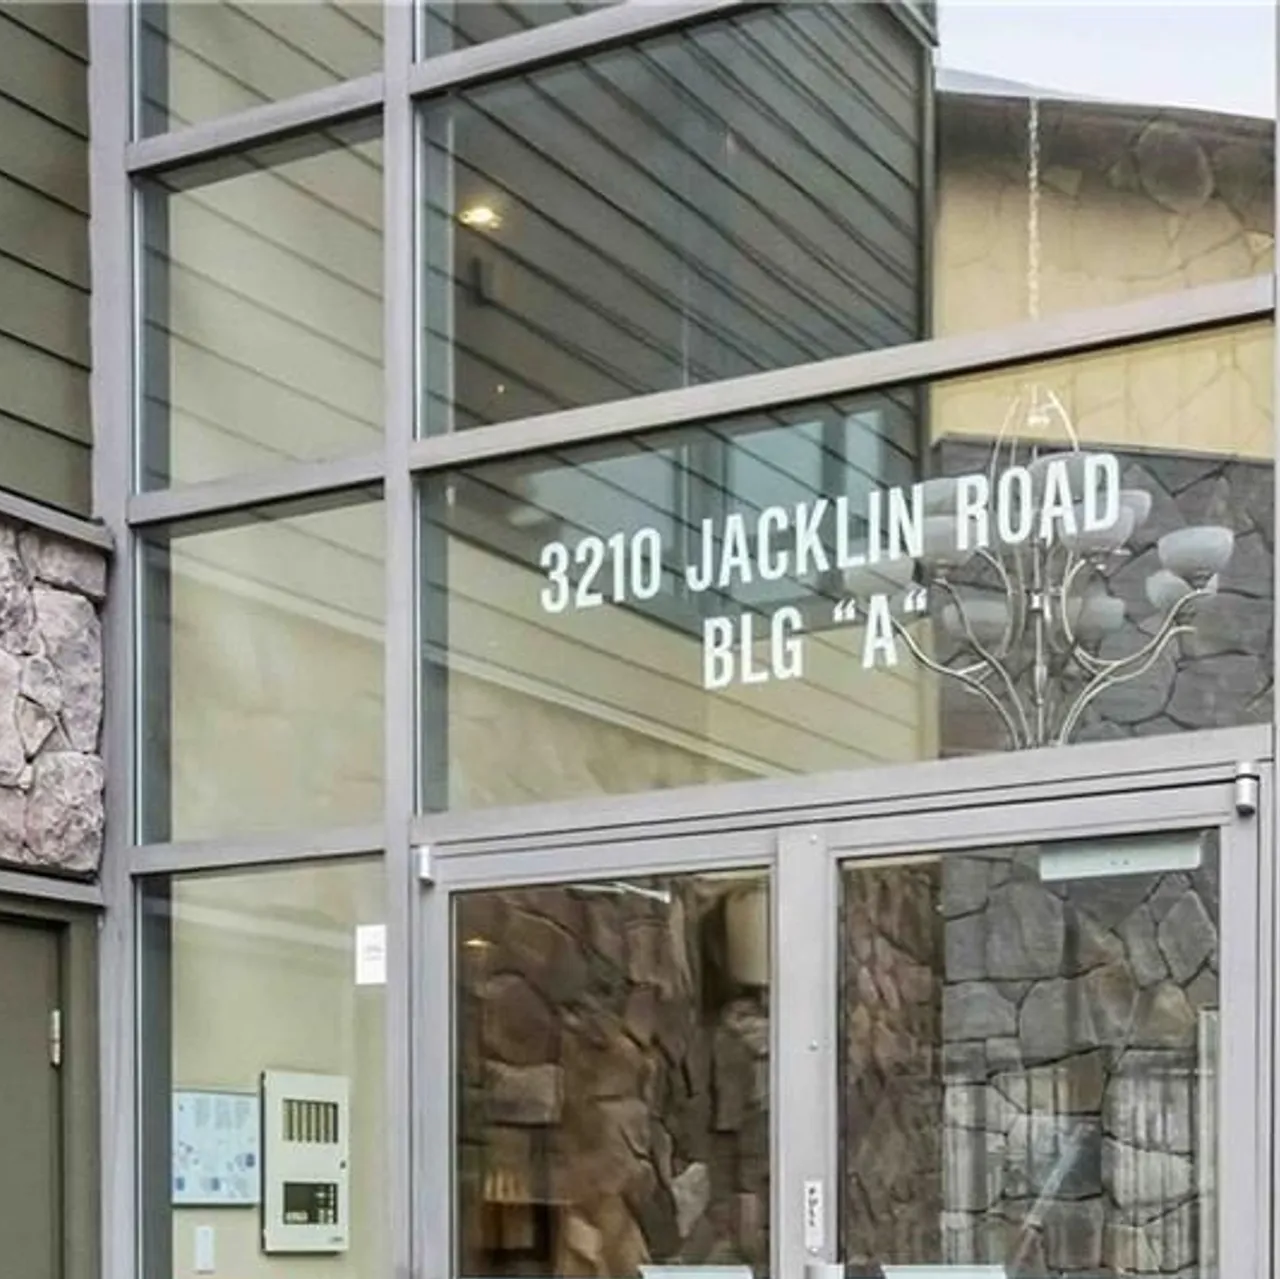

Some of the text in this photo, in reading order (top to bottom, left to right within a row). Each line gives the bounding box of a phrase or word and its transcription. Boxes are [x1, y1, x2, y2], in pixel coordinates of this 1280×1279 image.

[539, 453, 1121, 613] 3210 JACKLIN ROAD
[702, 606, 802, 688] BLG
